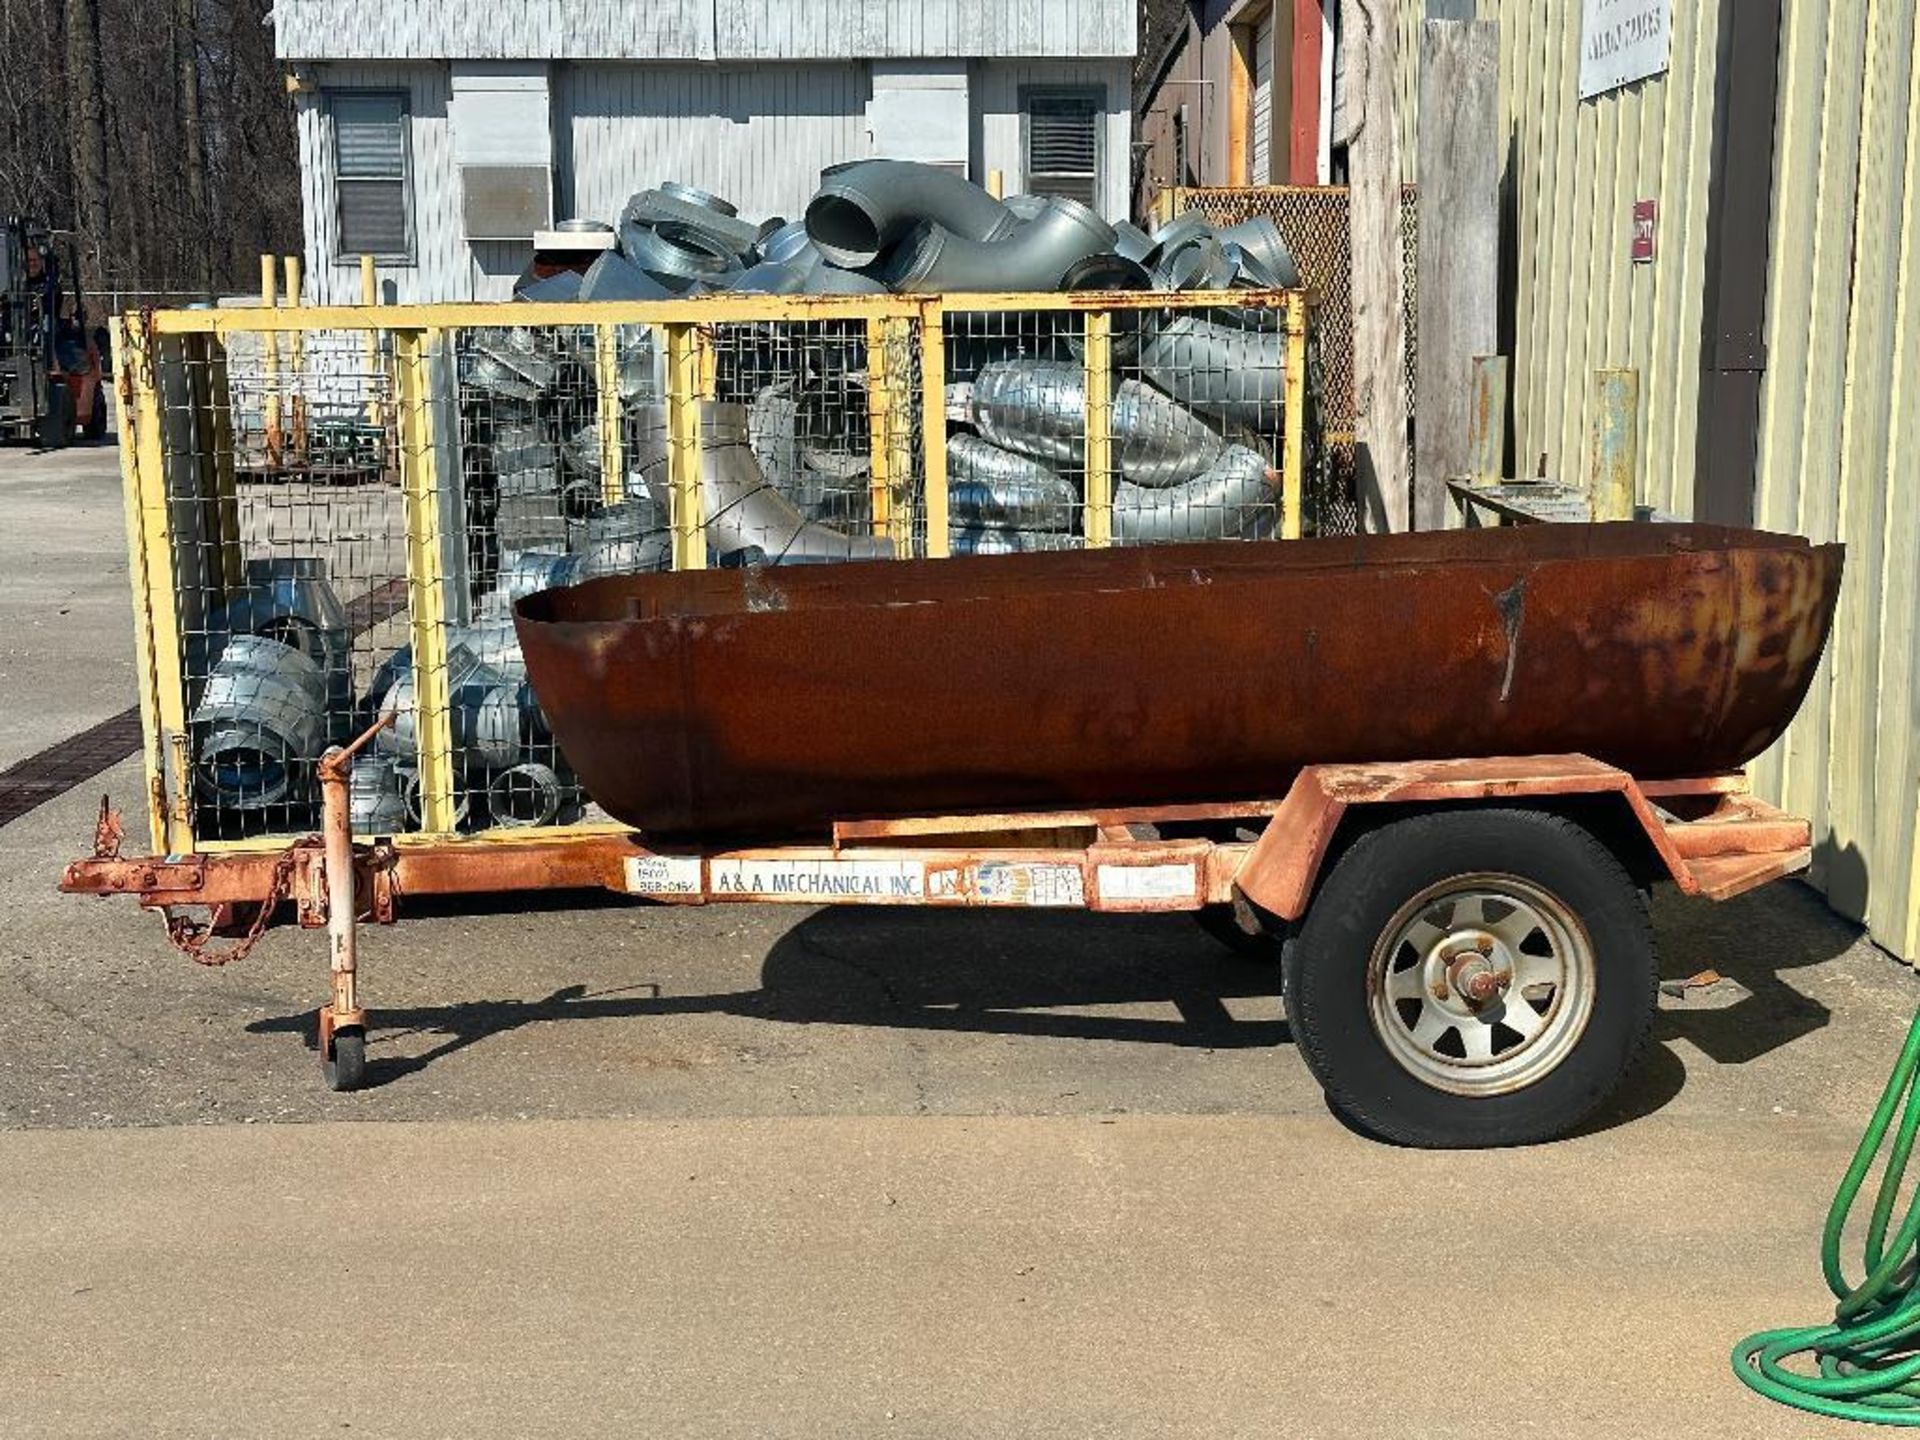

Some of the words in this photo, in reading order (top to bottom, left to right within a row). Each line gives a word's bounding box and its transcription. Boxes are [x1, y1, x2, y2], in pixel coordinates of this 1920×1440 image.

[719, 872, 730, 891] A
[733, 873, 747, 892] &
[752, 873, 764, 892] A
[772, 873, 881, 895] MECHANICAL
